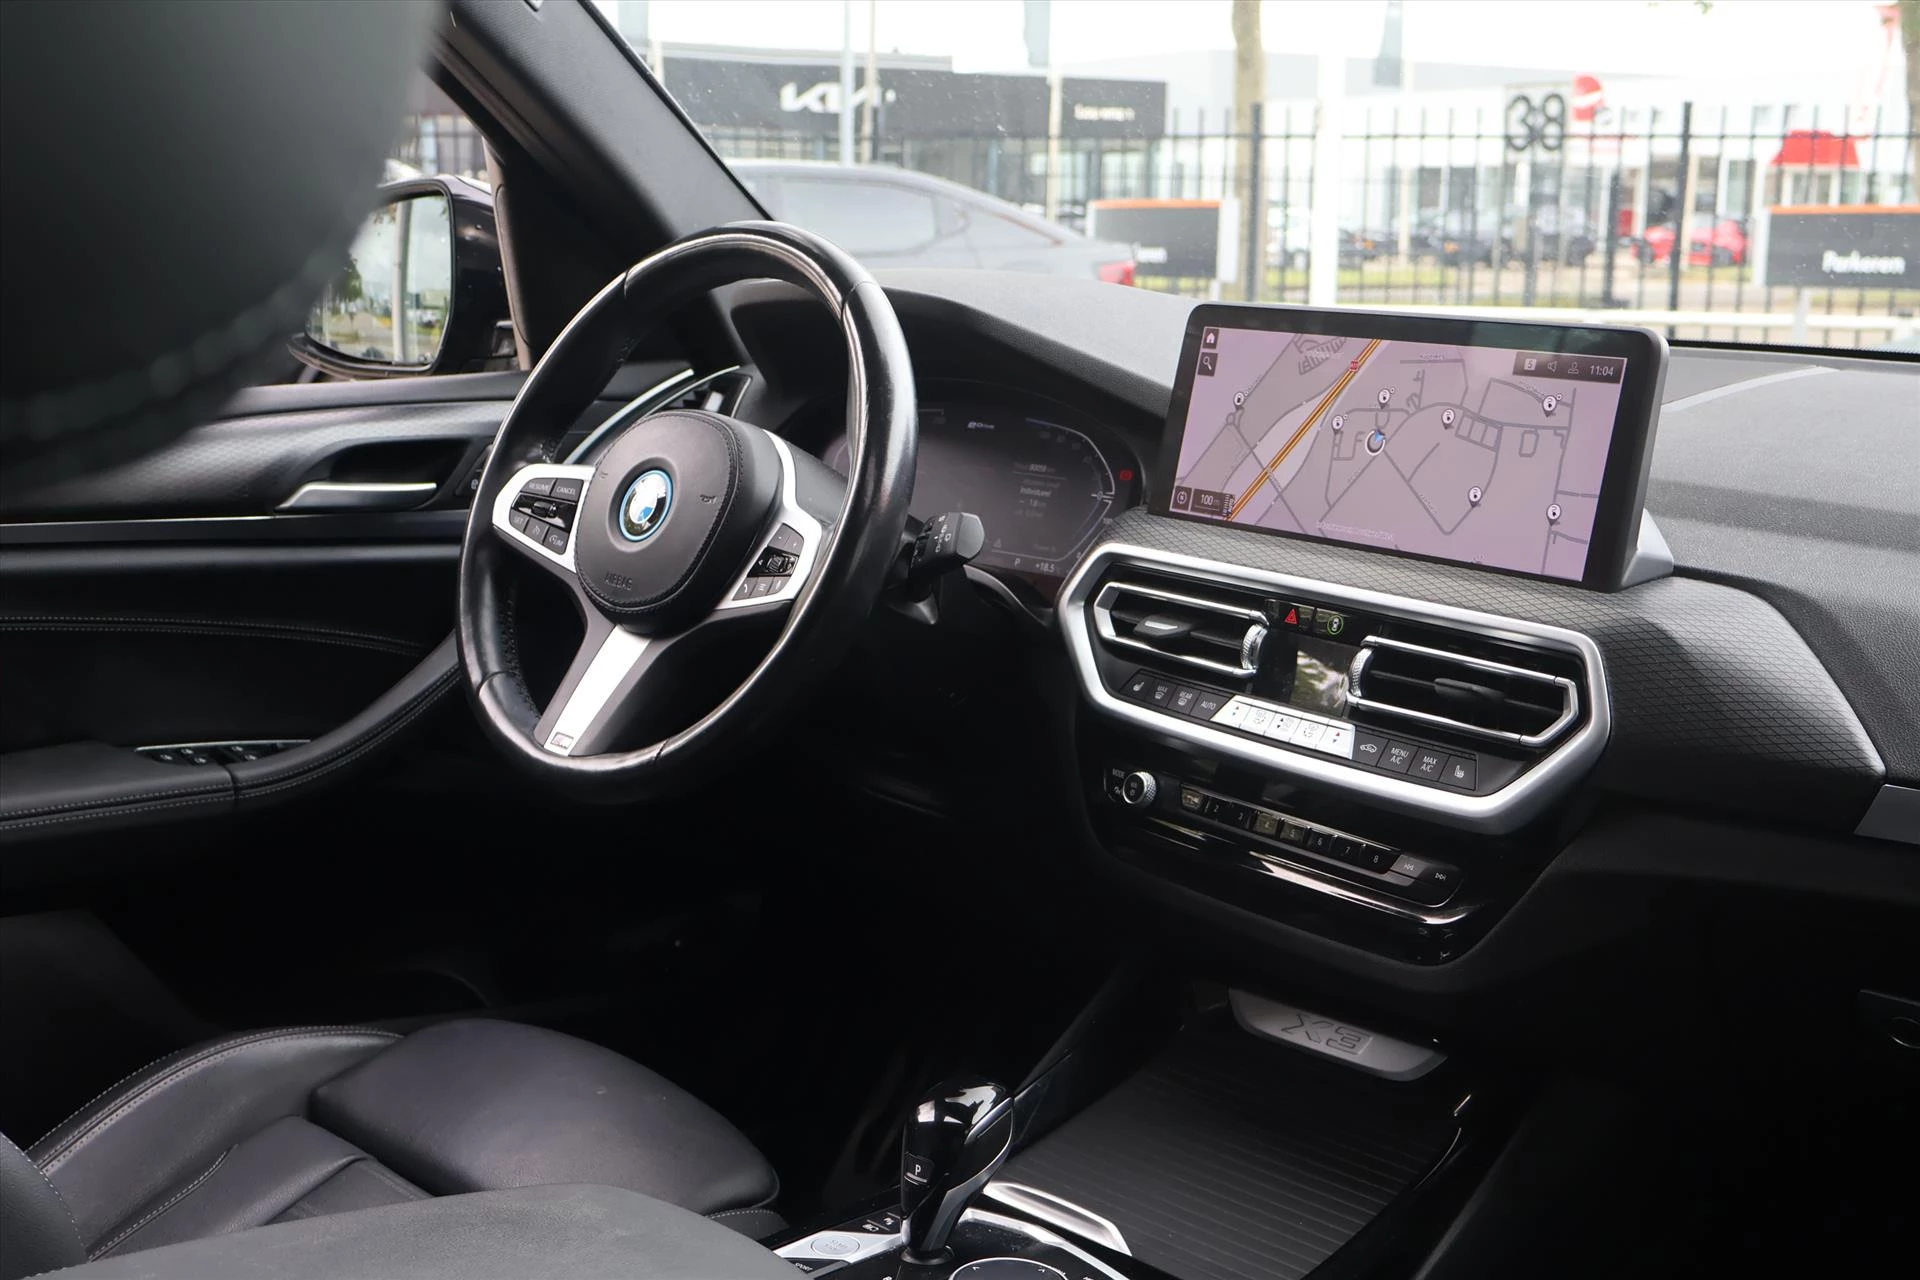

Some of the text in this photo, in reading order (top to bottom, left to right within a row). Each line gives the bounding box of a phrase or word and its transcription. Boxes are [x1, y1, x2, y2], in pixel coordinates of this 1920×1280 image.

[1504, 93, 1565, 151] 38
[1590, 365, 1614, 376] 11:04
[556, 486, 576, 495] CANCEL
[1201, 494, 1214, 506] 100
[1201, 700, 1217, 711] AUTO
[1391, 747, 1409, 758] MENU
[1390, 756, 1403, 765] A/C
[1422, 756, 1438, 766] MAX
[1420, 763, 1434, 773] A/C
[1281, 1012, 1374, 1056] X3
[915, 1164, 921, 1176] P
